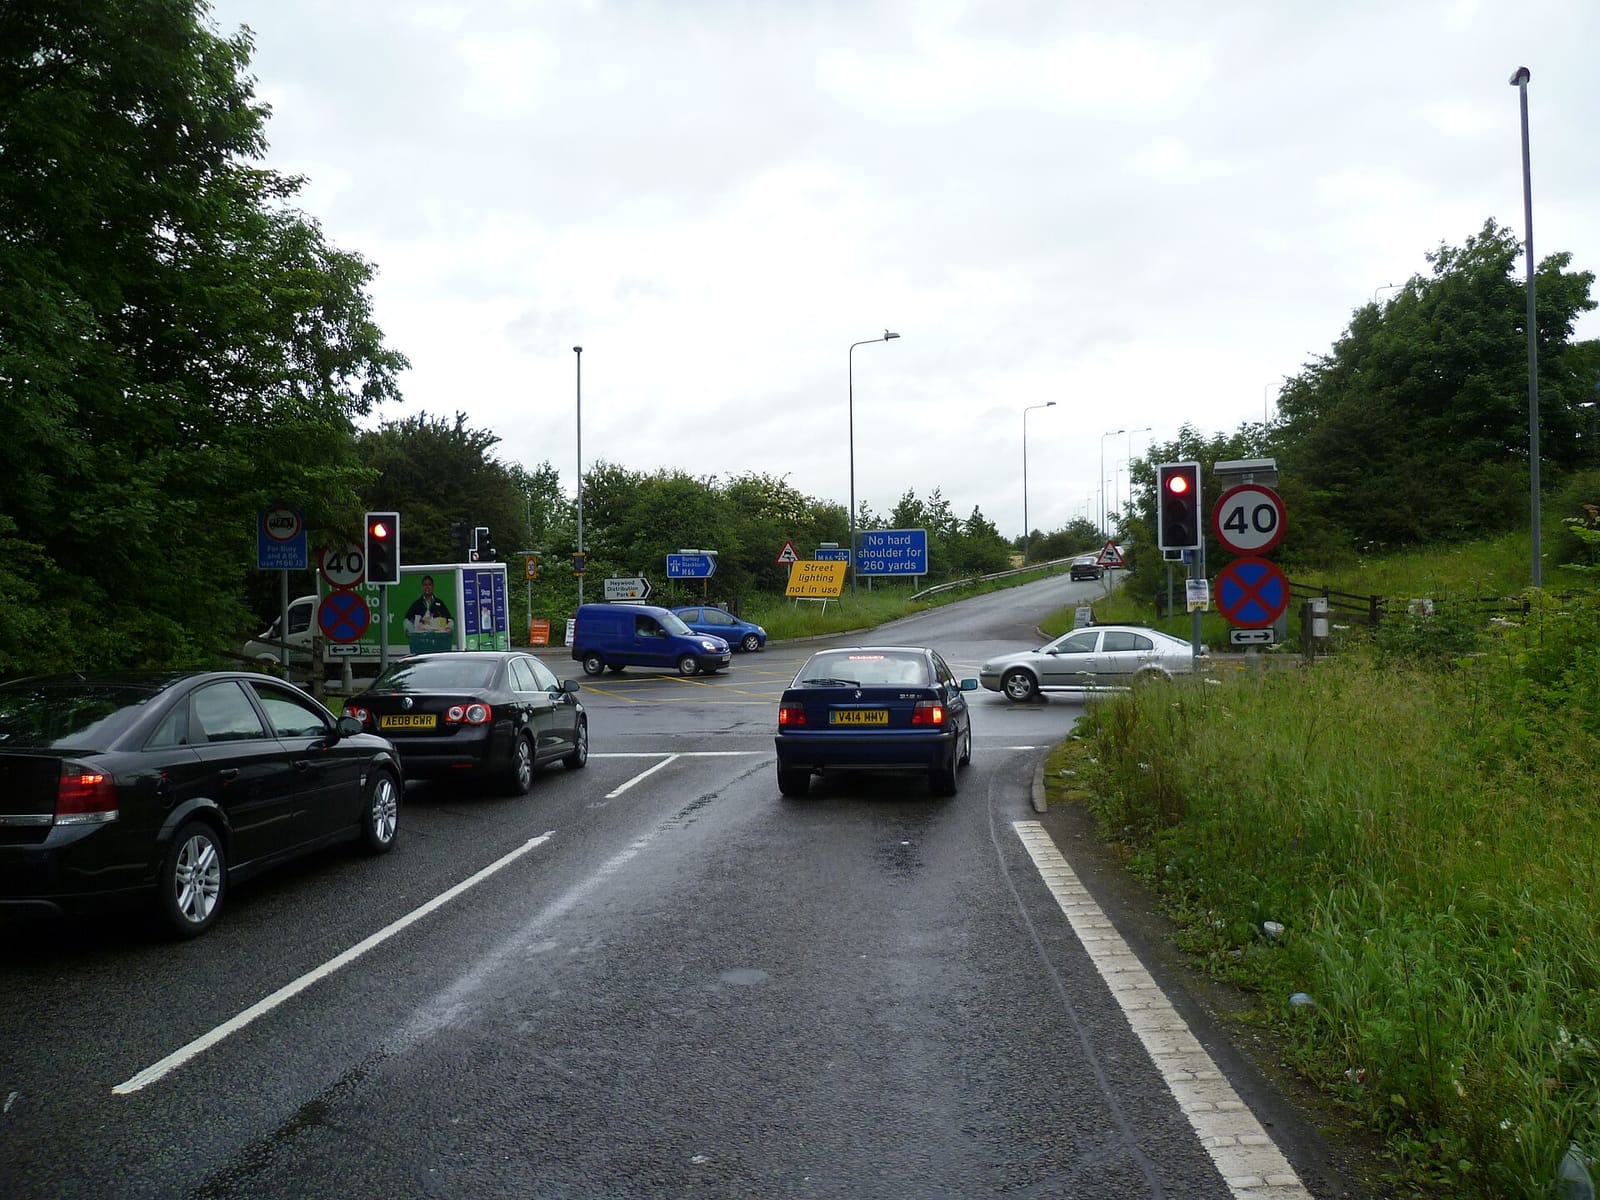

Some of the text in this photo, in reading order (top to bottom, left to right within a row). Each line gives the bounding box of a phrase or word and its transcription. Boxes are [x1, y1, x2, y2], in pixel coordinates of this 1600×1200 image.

[1223, 503, 1277, 534] 40
[868, 536, 911, 545] No hard
[858, 547, 922, 558] shoulder for
[326, 552, 363, 574] 40
[804, 564, 834, 572] Street
[863, 560, 917, 572] 260 yards
[798, 573, 834, 583] lighting
[386, 715, 433, 726] AE08 GWR
[839, 711, 861, 722] V414
